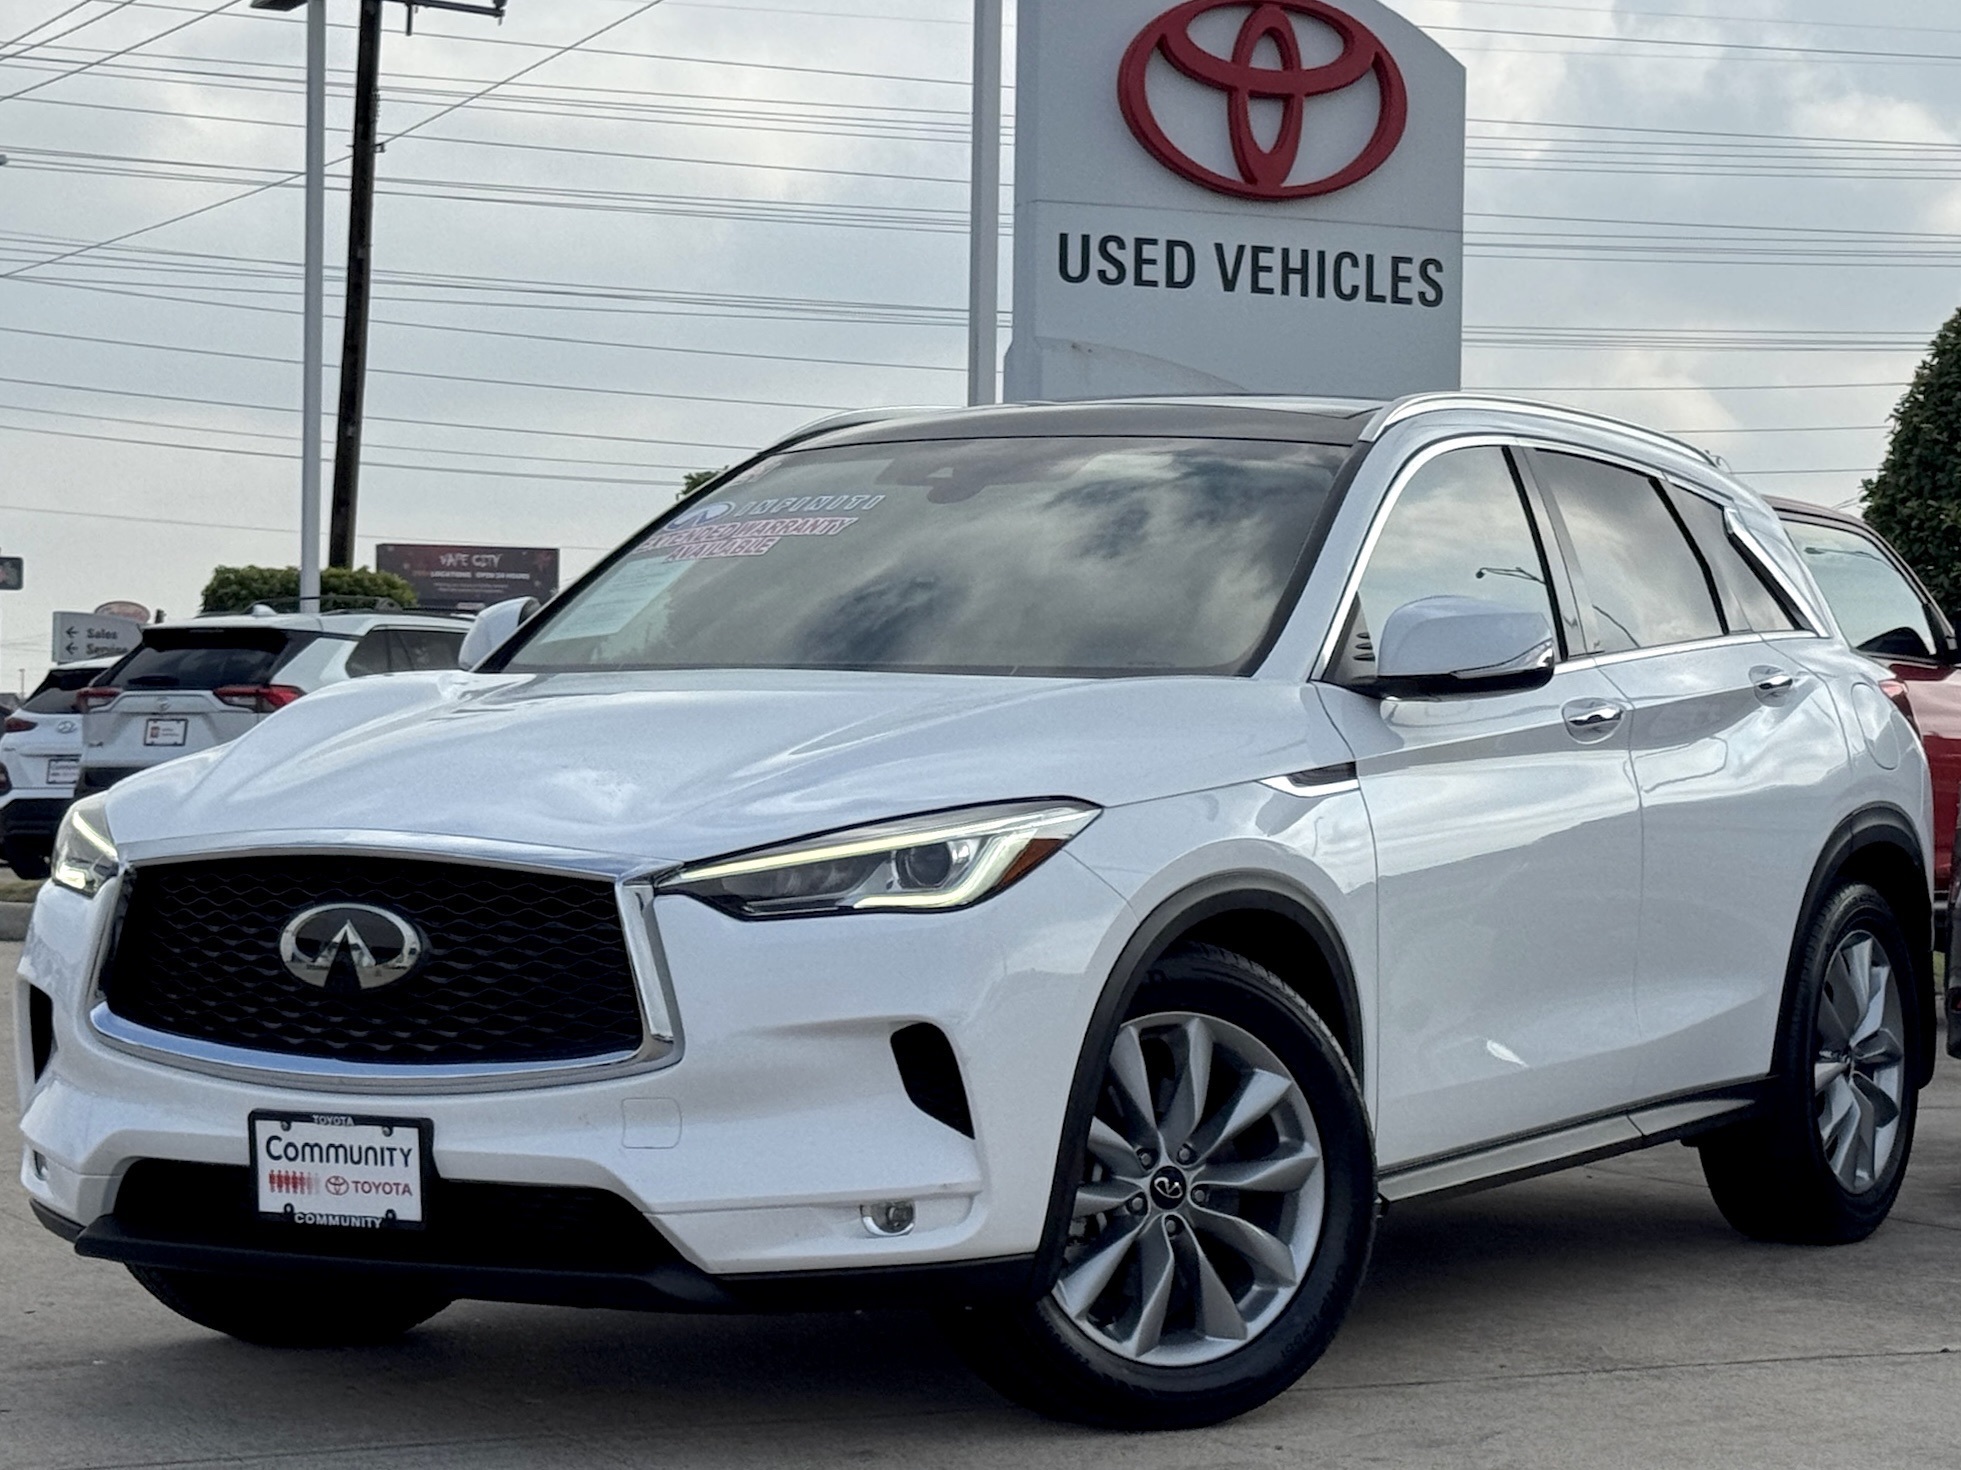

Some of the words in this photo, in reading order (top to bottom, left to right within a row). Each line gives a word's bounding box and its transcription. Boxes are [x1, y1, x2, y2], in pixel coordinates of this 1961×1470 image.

[1058, 232, 1196, 290] USED
[1213, 242, 1444, 308] VEHICLES
[734, 494, 886, 517] INFINITI
[734, 518, 857, 536] WARRANTY
[665, 538, 780, 561] AVAILABLE
[440, 553, 469, 567] VAPE
[473, 554, 502, 568] CITY
[86, 627, 119, 640] Sales
[312, 1114, 355, 1127] TOYOTA
[351, 1180, 413, 1197] TOYOTA
[294, 1212, 383, 1229] COMMUNITY
